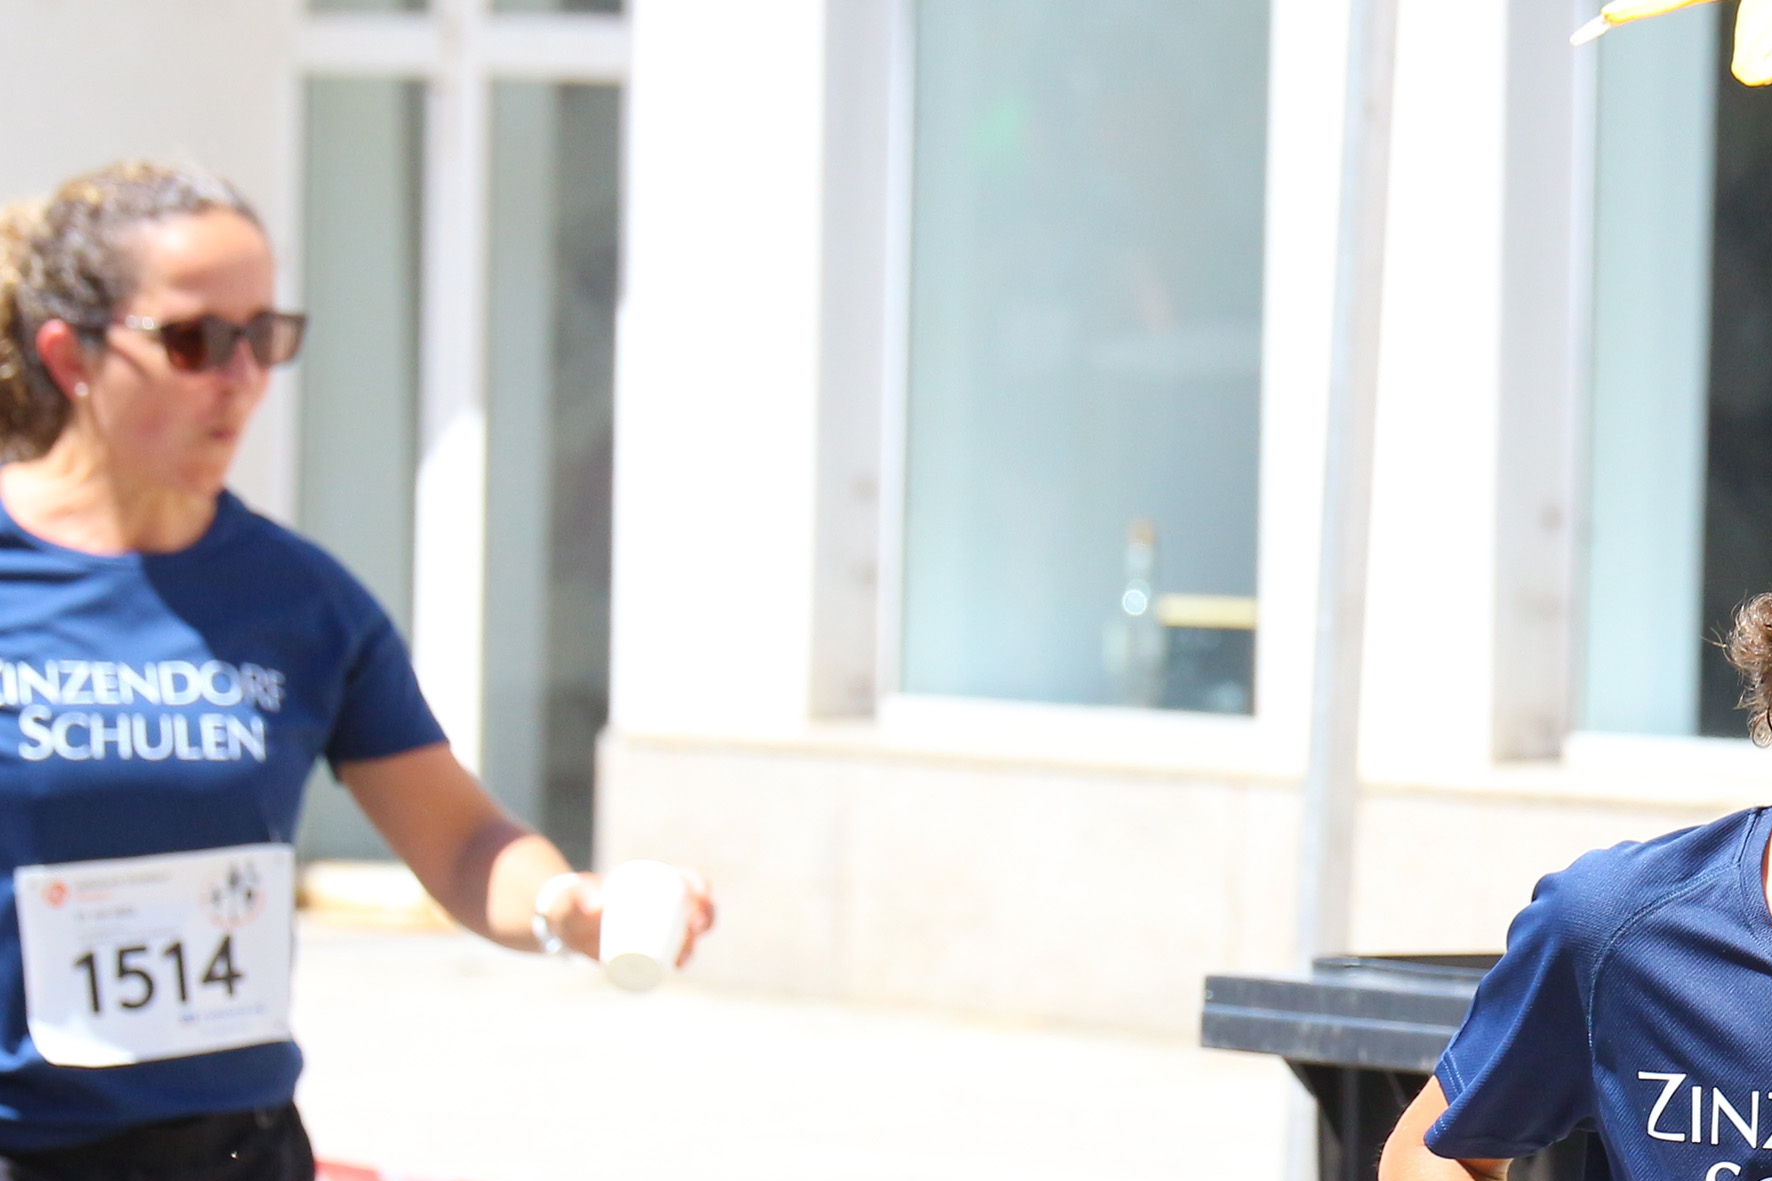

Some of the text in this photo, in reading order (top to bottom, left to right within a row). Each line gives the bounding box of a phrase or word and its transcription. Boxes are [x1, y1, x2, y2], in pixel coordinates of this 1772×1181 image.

[0, 658, 287, 712] INZENDORF
[18, 705, 267, 762] SCHULEN
[73, 935, 243, 1017] 1514
